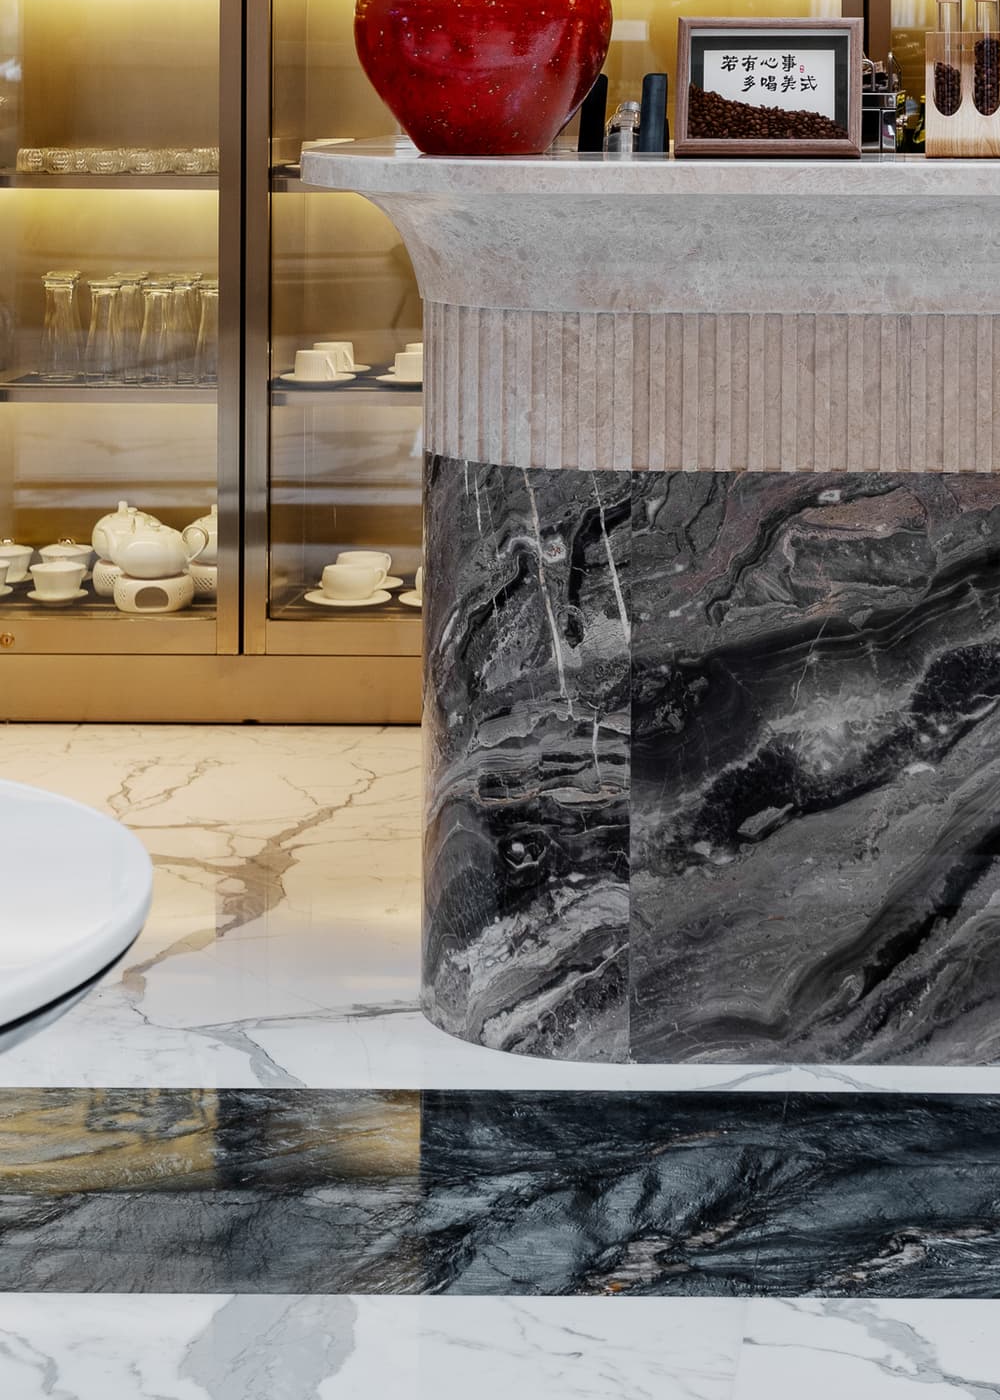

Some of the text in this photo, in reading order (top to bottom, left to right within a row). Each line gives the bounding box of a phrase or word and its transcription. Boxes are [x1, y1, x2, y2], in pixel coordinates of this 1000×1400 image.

[721, 54, 797, 72] 若有心事
[741, 75, 818, 93] 多喝美式
